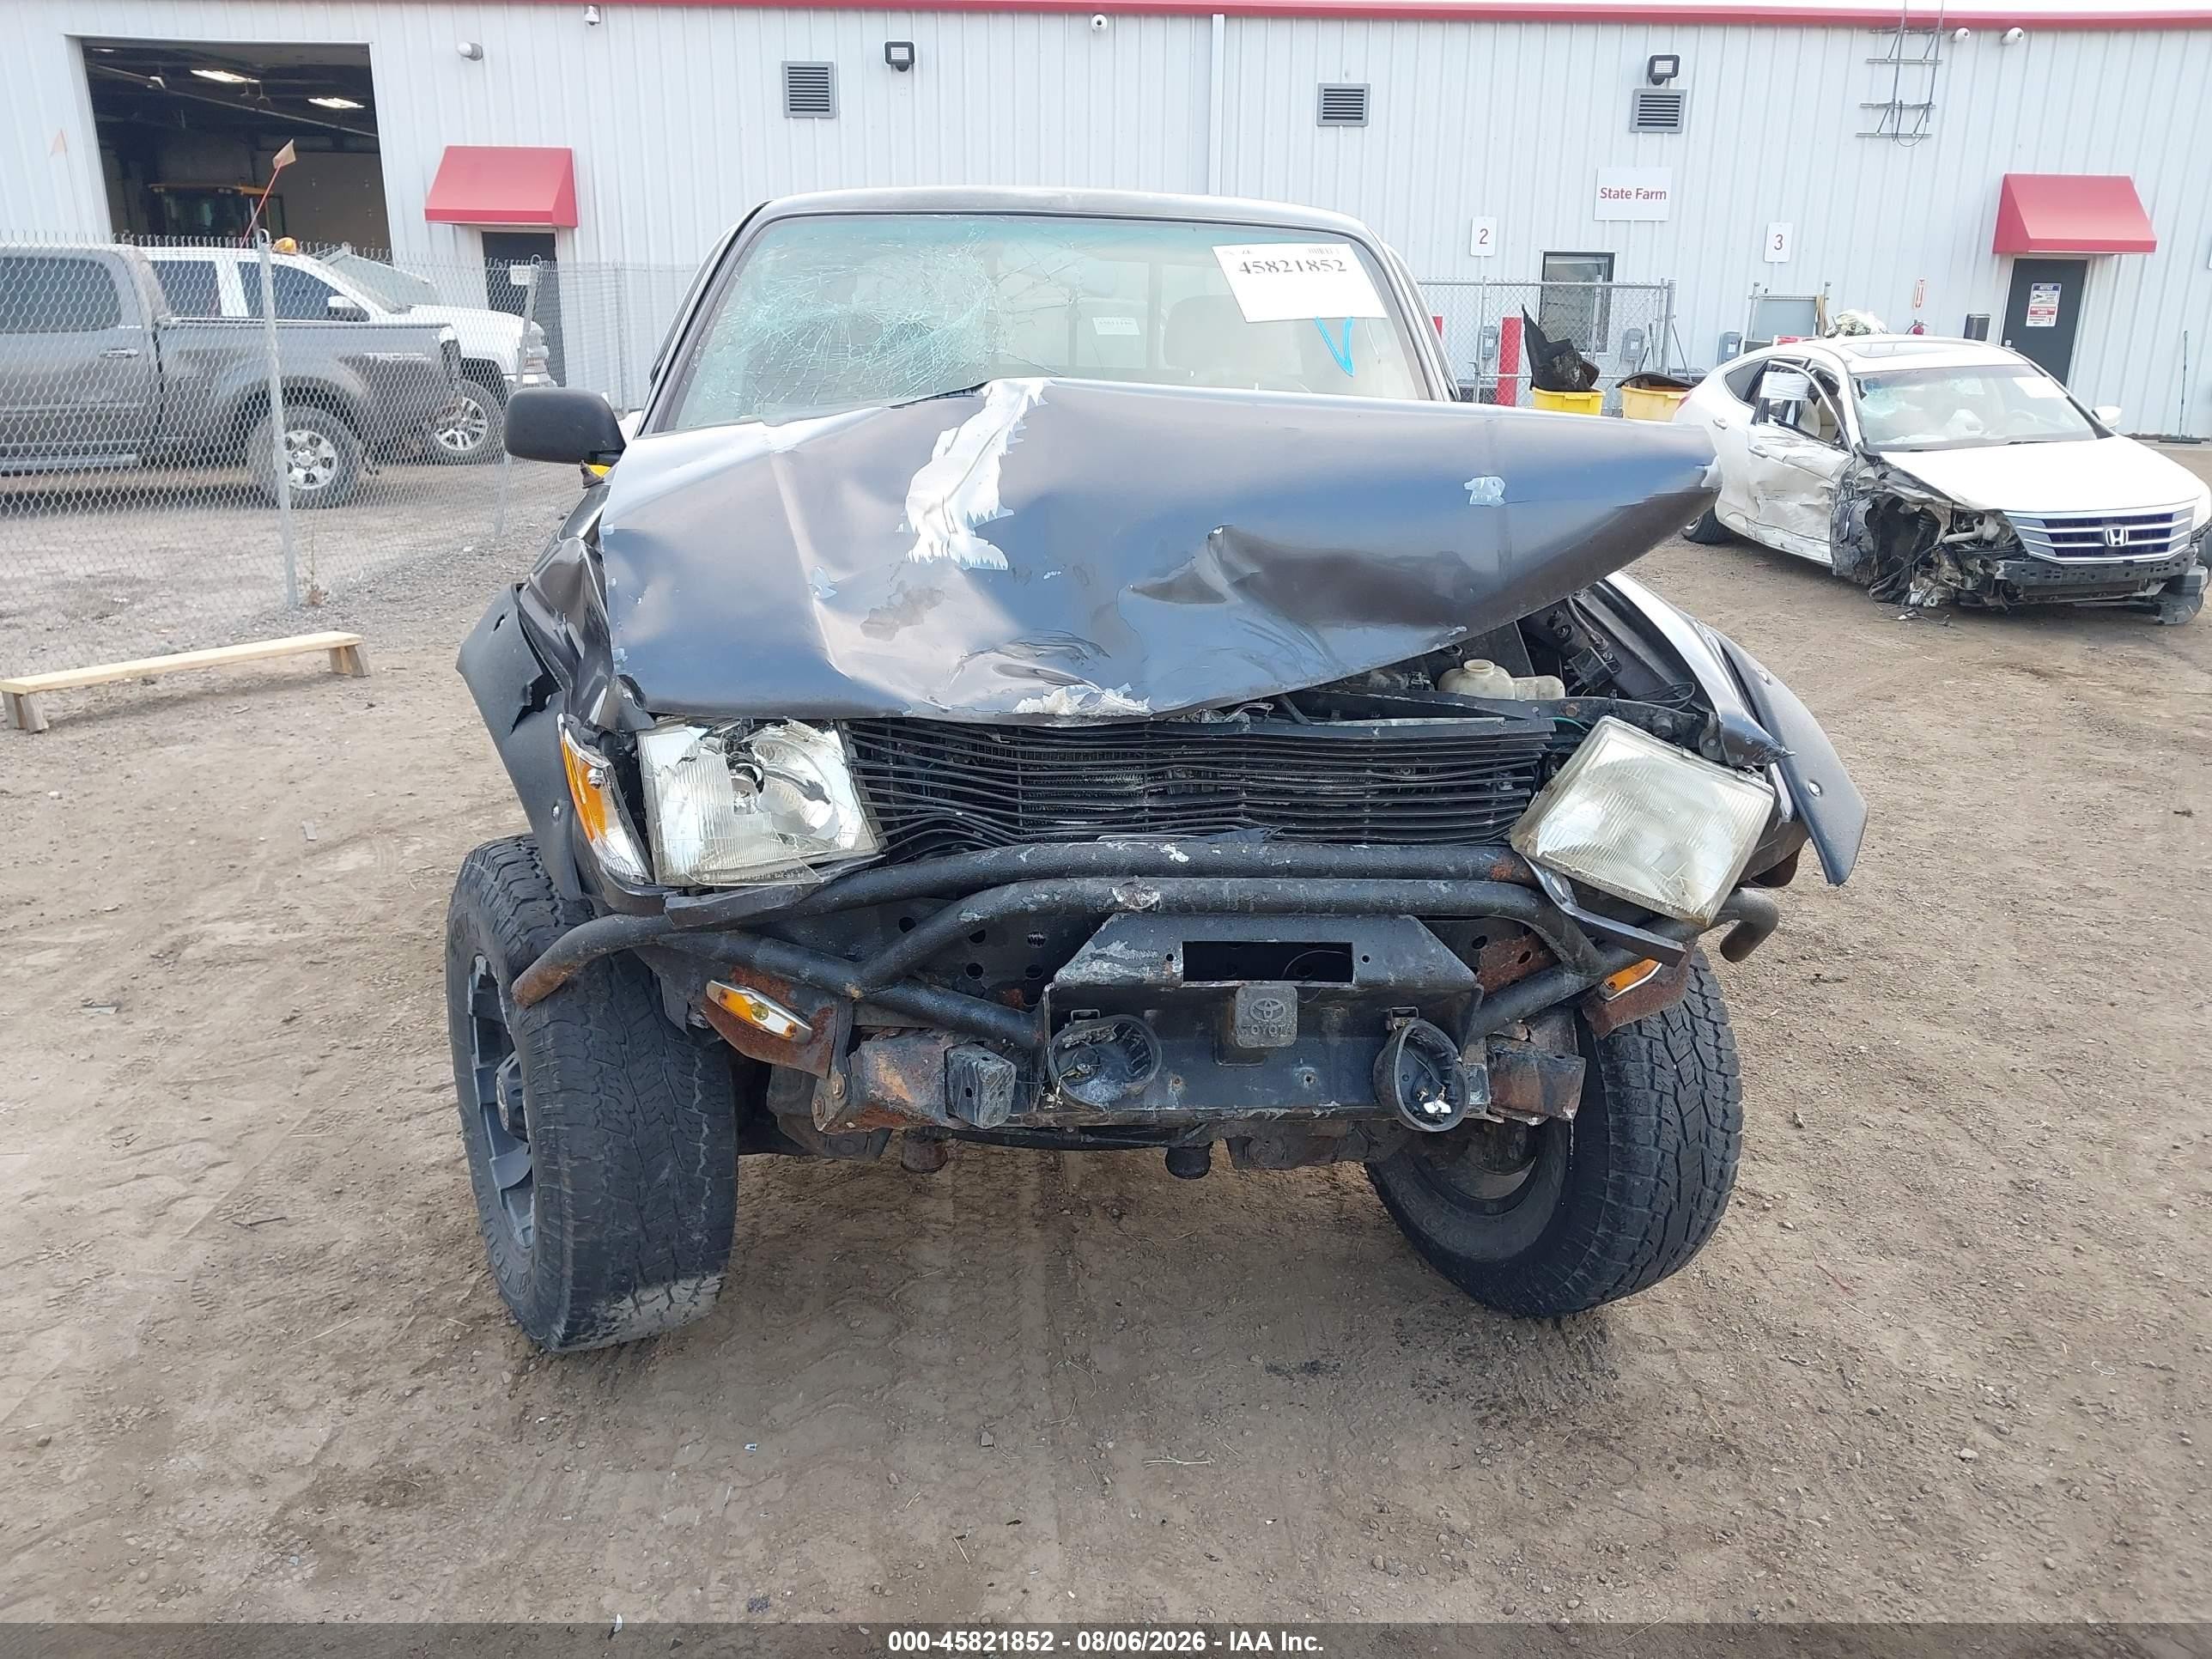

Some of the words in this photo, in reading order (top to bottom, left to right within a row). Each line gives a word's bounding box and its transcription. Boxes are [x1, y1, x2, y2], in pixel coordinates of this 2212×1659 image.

[1600, 186, 1632, 199] State
[1635, 187, 1667, 200] Farm
[1479, 228, 1489, 246] 2
[1773, 234, 1784, 251] 3
[1237, 258, 1347, 275] 45821852
[1243, 1024, 1293, 1036] TOYOTA
